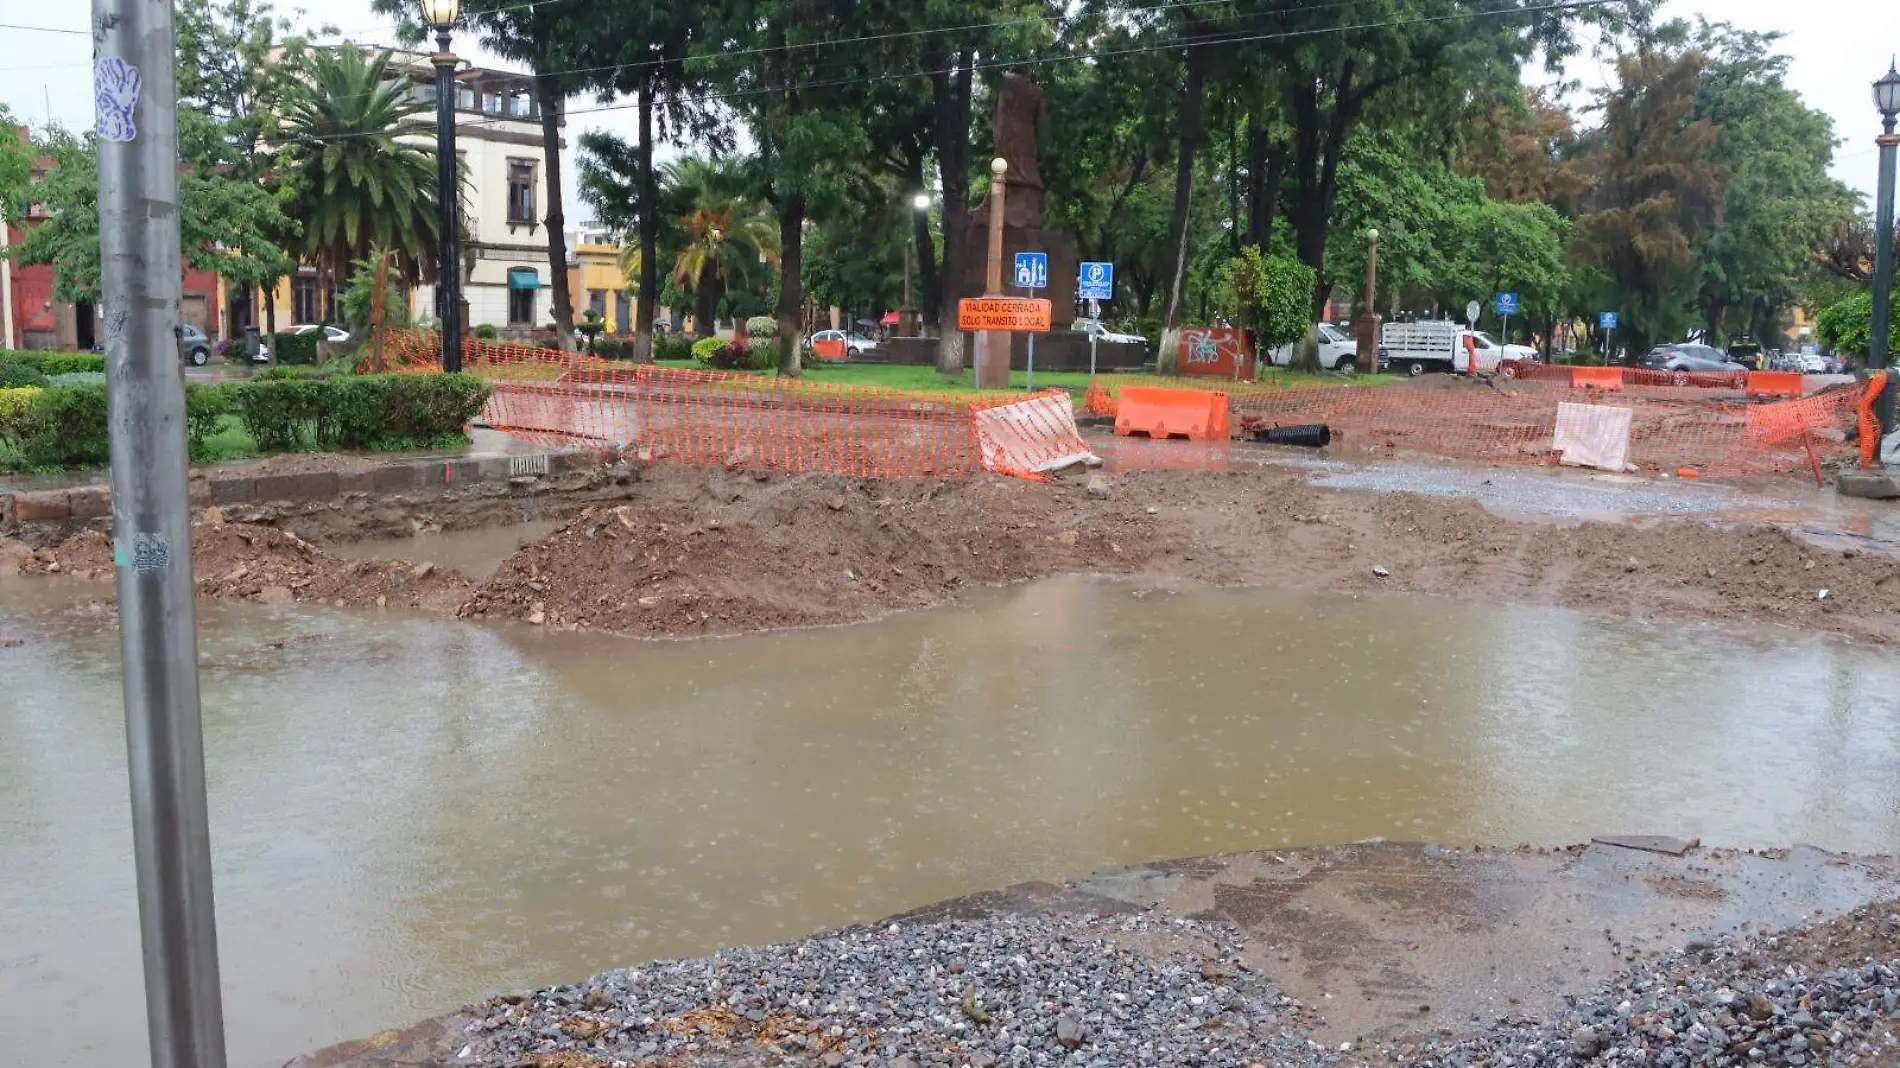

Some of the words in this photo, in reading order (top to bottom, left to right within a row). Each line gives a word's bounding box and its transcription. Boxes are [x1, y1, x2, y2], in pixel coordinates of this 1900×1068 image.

[965, 303, 1000, 313] VIALIDAD
[1002, 303, 1041, 313] CERRADA
[983, 316, 1017, 326] TRANSITO
[1019, 316, 1046, 327] LOCAL
